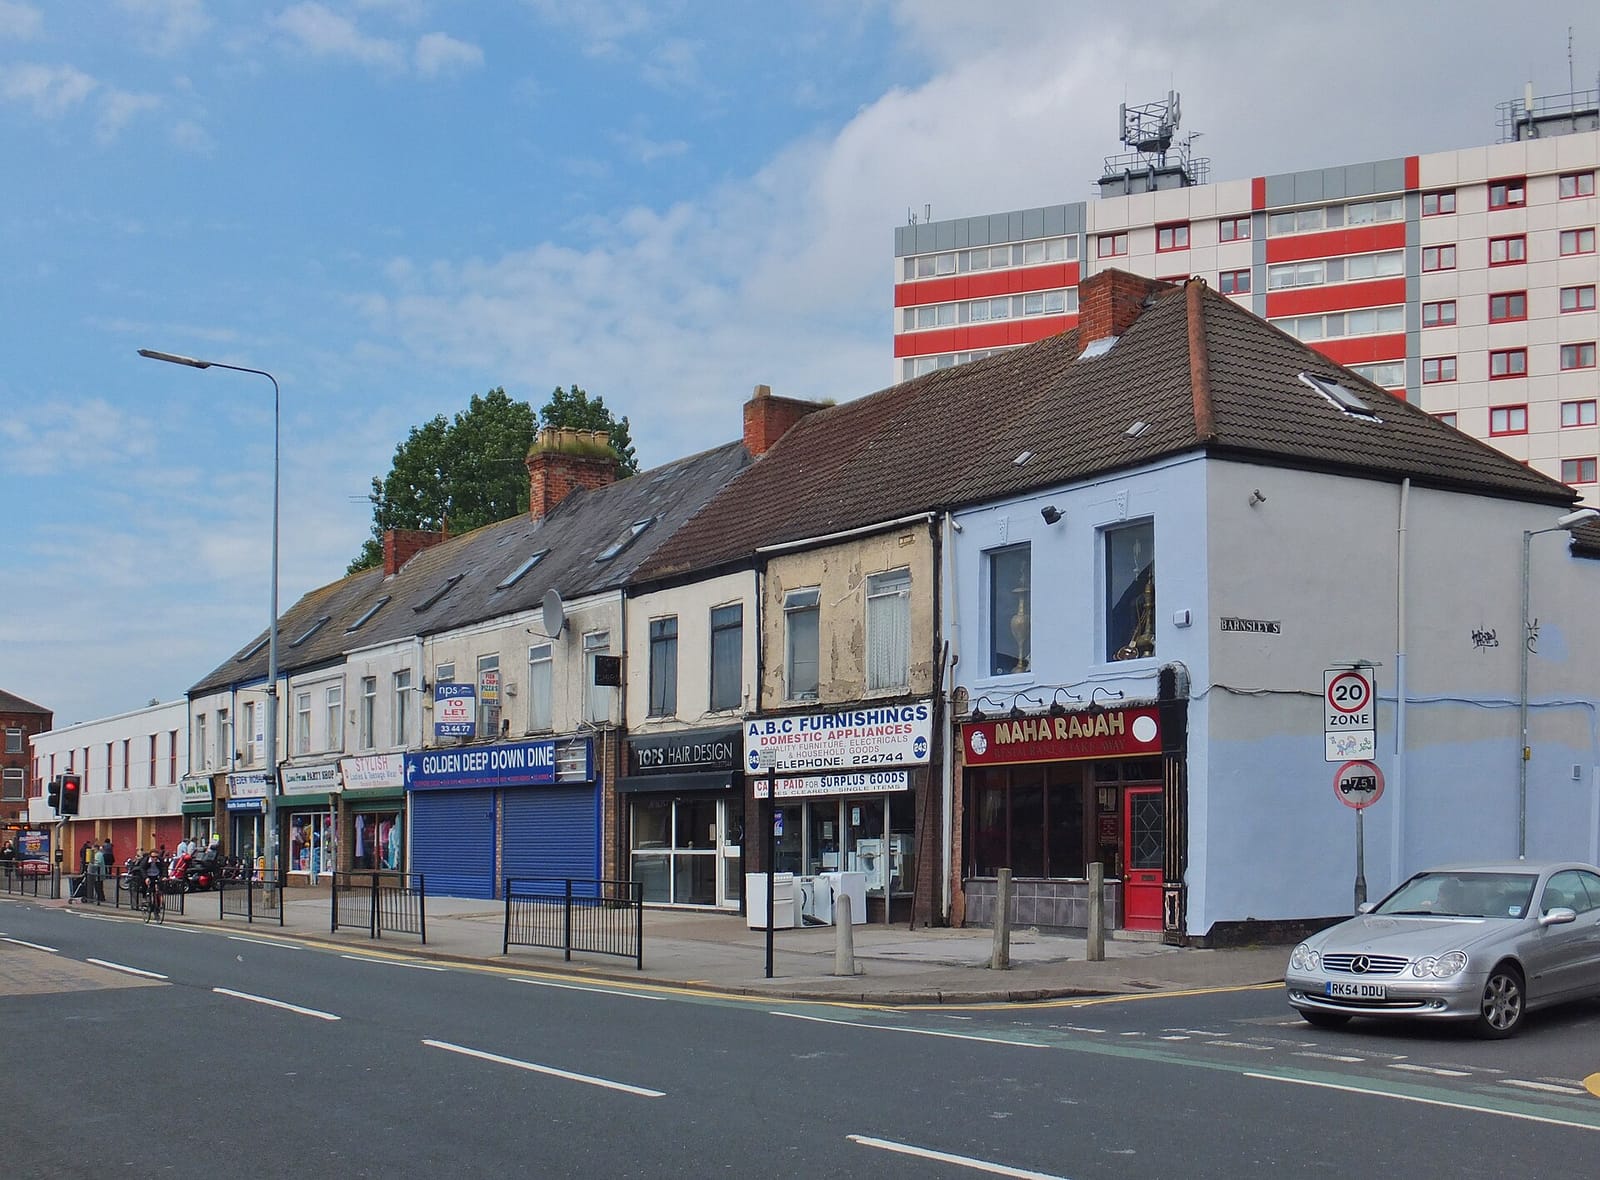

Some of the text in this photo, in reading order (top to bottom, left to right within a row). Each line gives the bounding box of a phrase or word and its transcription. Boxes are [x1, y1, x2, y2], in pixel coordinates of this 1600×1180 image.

[1221, 620, 1268, 632] BARNSLEY
[439, 686, 458, 697] nps
[1335, 685, 1363, 701] 20
[749, 705, 928, 736] A.B.C FURNISHINGS
[1330, 714, 1369, 725] ZONE
[760, 723, 913, 746] DOMESTIC APPLIANCES
[850, 735, 908, 746] ELECTRICALS
[638, 742, 733, 766] TOPS HAIR DESIGN
[796, 748, 846, 758] HOUSEHOLD
[849, 745, 880, 754] GOODS
[914, 742, 927, 753] 243
[356, 756, 388, 772] STYLISH
[422, 755, 461, 774] GOLDEN
[463, 752, 488, 771] DEEP
[491, 748, 524, 770] DOWN
[776, 757, 844, 769] ELEPHONE:
[852, 752, 903, 764] 224744
[322, 770, 334, 780] SHOP
[757, 781, 779, 790] CAH
[784, 779, 804, 789] PAID
[820, 774, 865, 788] SURPLUS
[870, 772, 905, 785] GOODS
[1332, 984, 1383, 996] RK54 DDU
